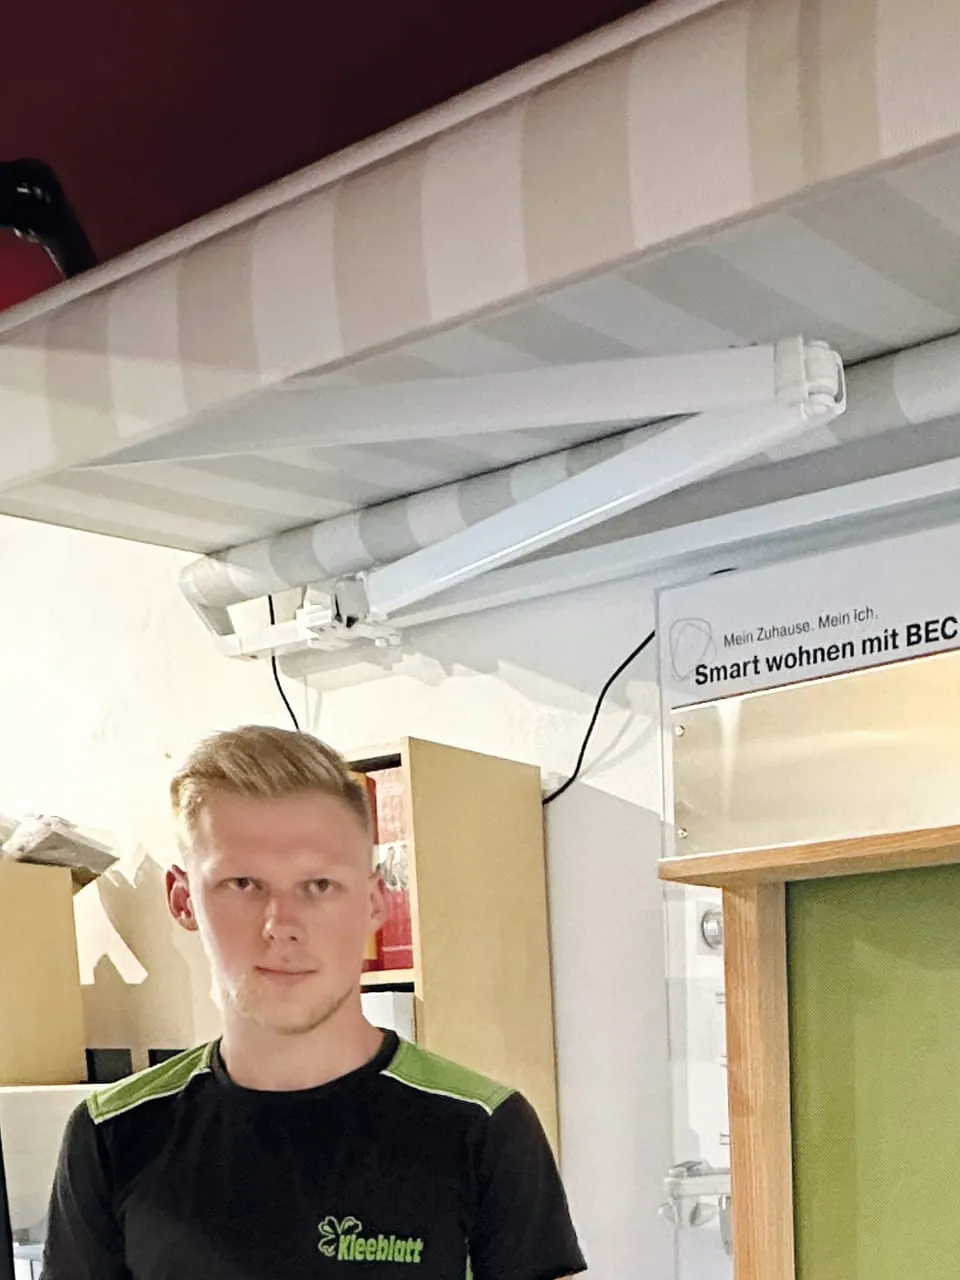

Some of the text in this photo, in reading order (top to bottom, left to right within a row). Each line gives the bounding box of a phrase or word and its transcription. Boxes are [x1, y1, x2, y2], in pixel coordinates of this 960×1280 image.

[723, 632, 754, 648] Mein
[756, 620, 815, 642] Zuhause.
[818, 614, 850, 630] Mein
[695, 655, 760, 686] Smart
[765, 641, 855, 673] wohnen
[861, 628, 899, 655] mit
[338, 1234, 424, 1263] Kleeblatt
